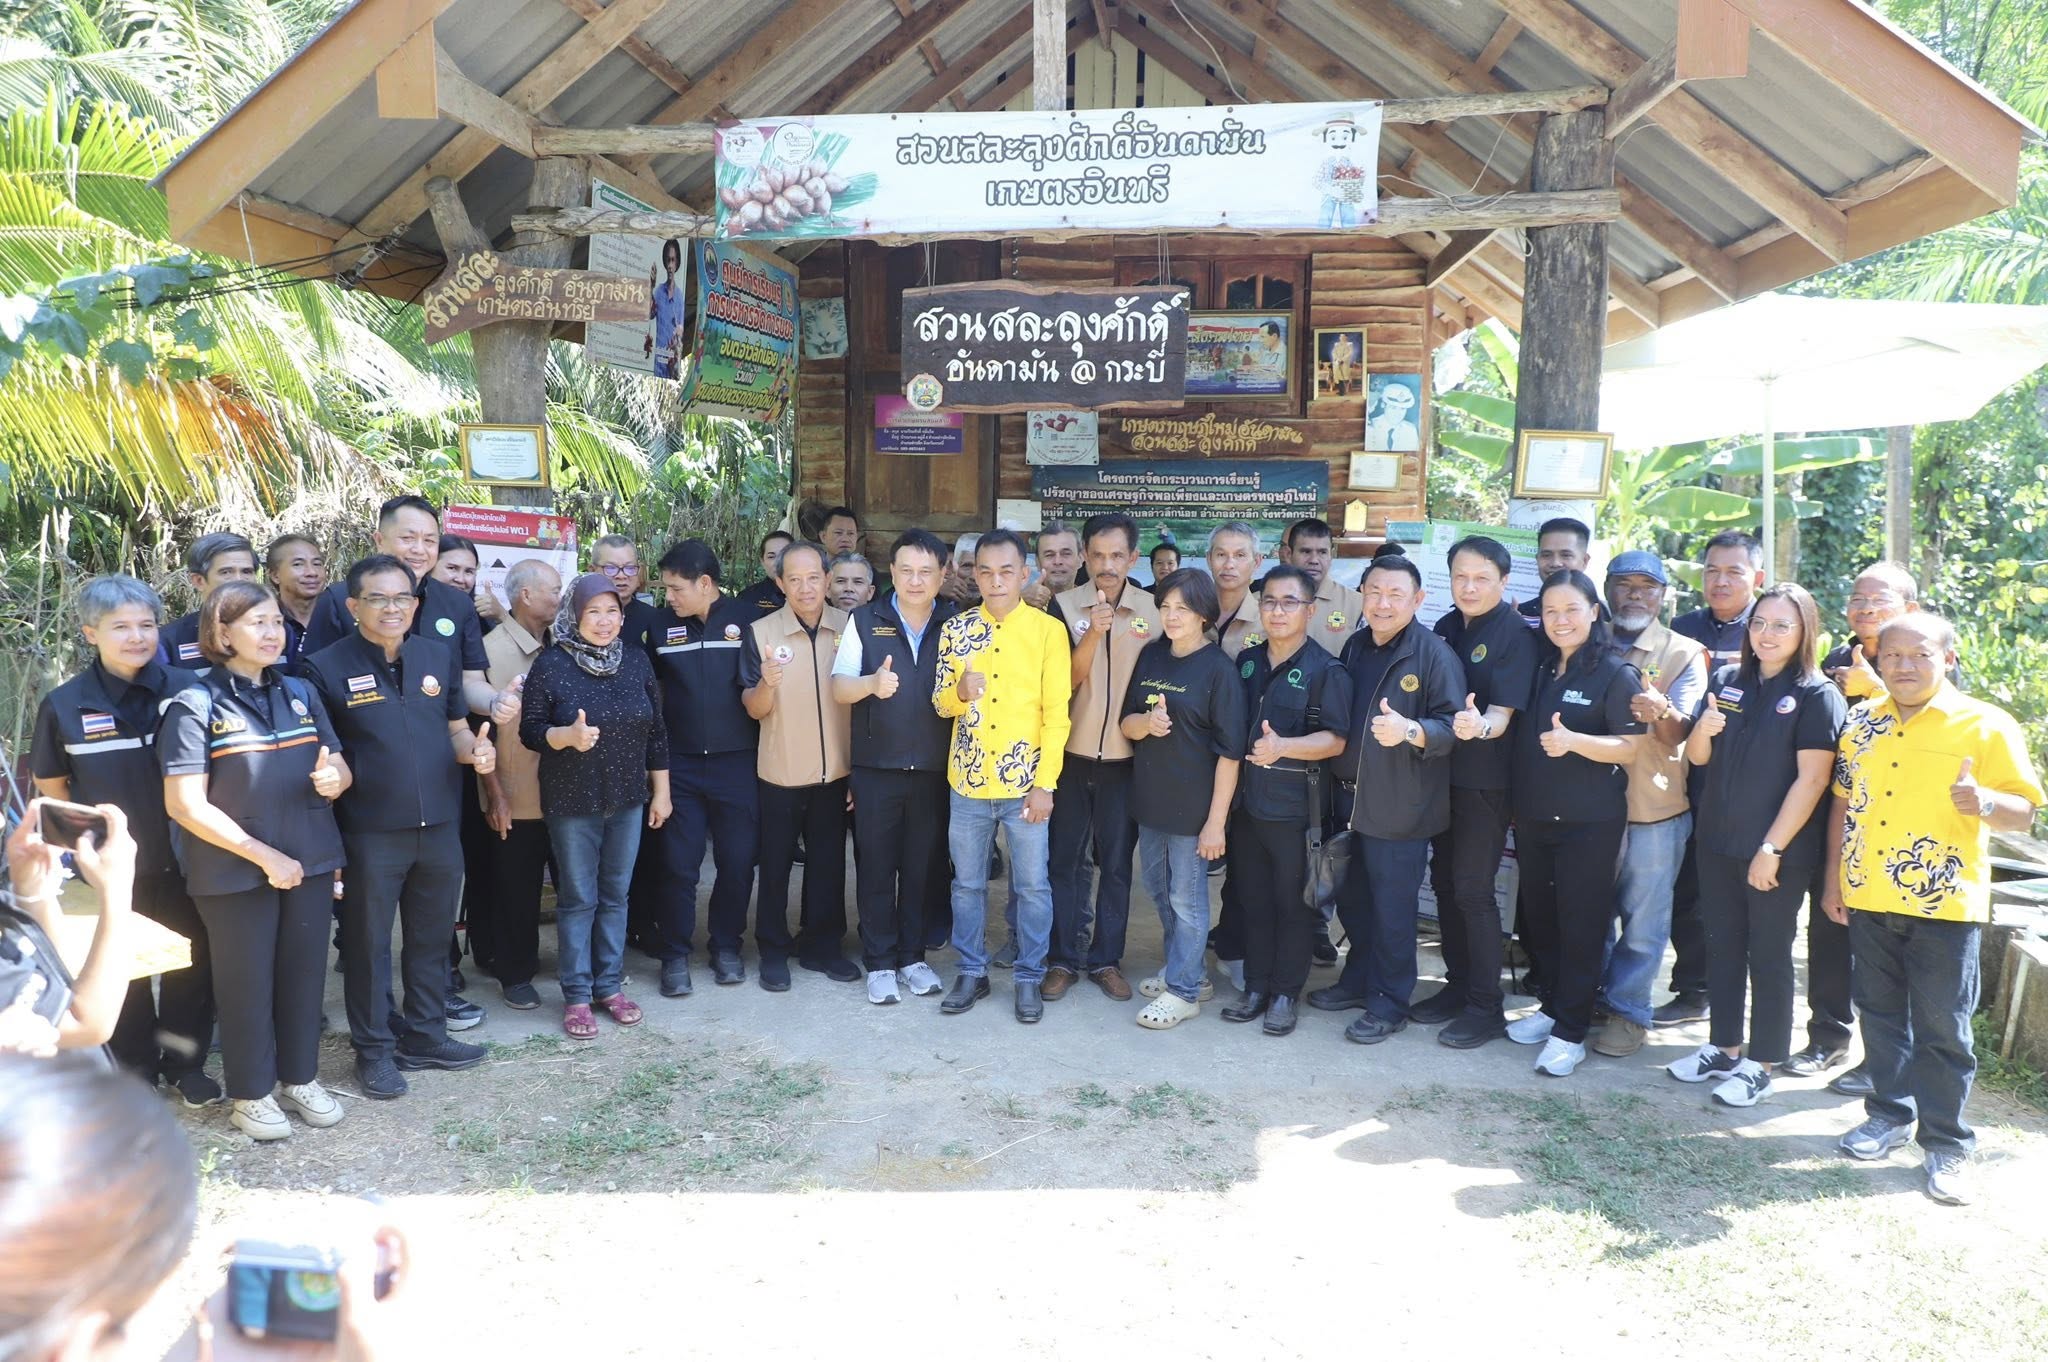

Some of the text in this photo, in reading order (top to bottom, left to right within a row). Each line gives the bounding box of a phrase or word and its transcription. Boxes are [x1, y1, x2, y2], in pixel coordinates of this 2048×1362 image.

[897, 111, 1266, 171] สวนสละลุงศักดิ์อันดามัน
[986, 164, 1170, 206] เกษตรอินทรี
[563, 274, 645, 303] อันดามัน
[946, 348, 1060, 382] อันดามัน
[1071, 360, 1096, 384] @
[1098, 471, 1261, 489] โครงการจัดกระบวนการเรียนรู้
